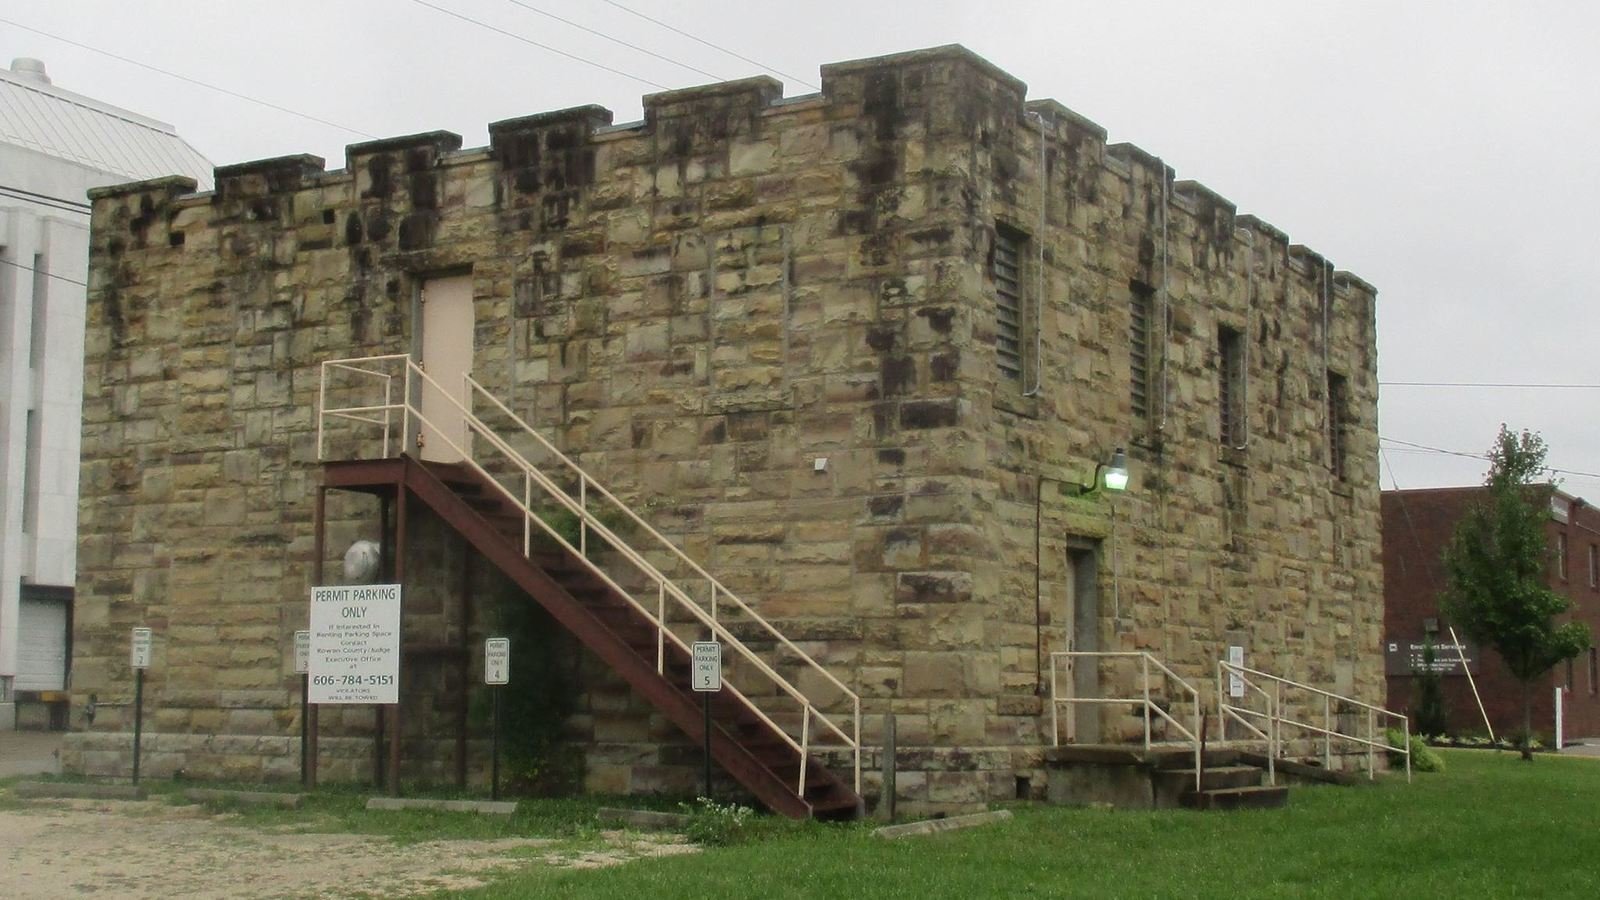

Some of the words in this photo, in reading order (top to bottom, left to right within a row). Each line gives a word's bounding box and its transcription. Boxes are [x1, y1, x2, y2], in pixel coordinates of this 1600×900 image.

[316, 590, 349, 601] PERMIT
[353, 588, 396, 600] PARKING
[342, 607, 367, 618] ONLY
[494, 670, 500, 679] 4
[313, 675, 394, 685] 606-784-5151
[704, 676, 710, 685] 5
